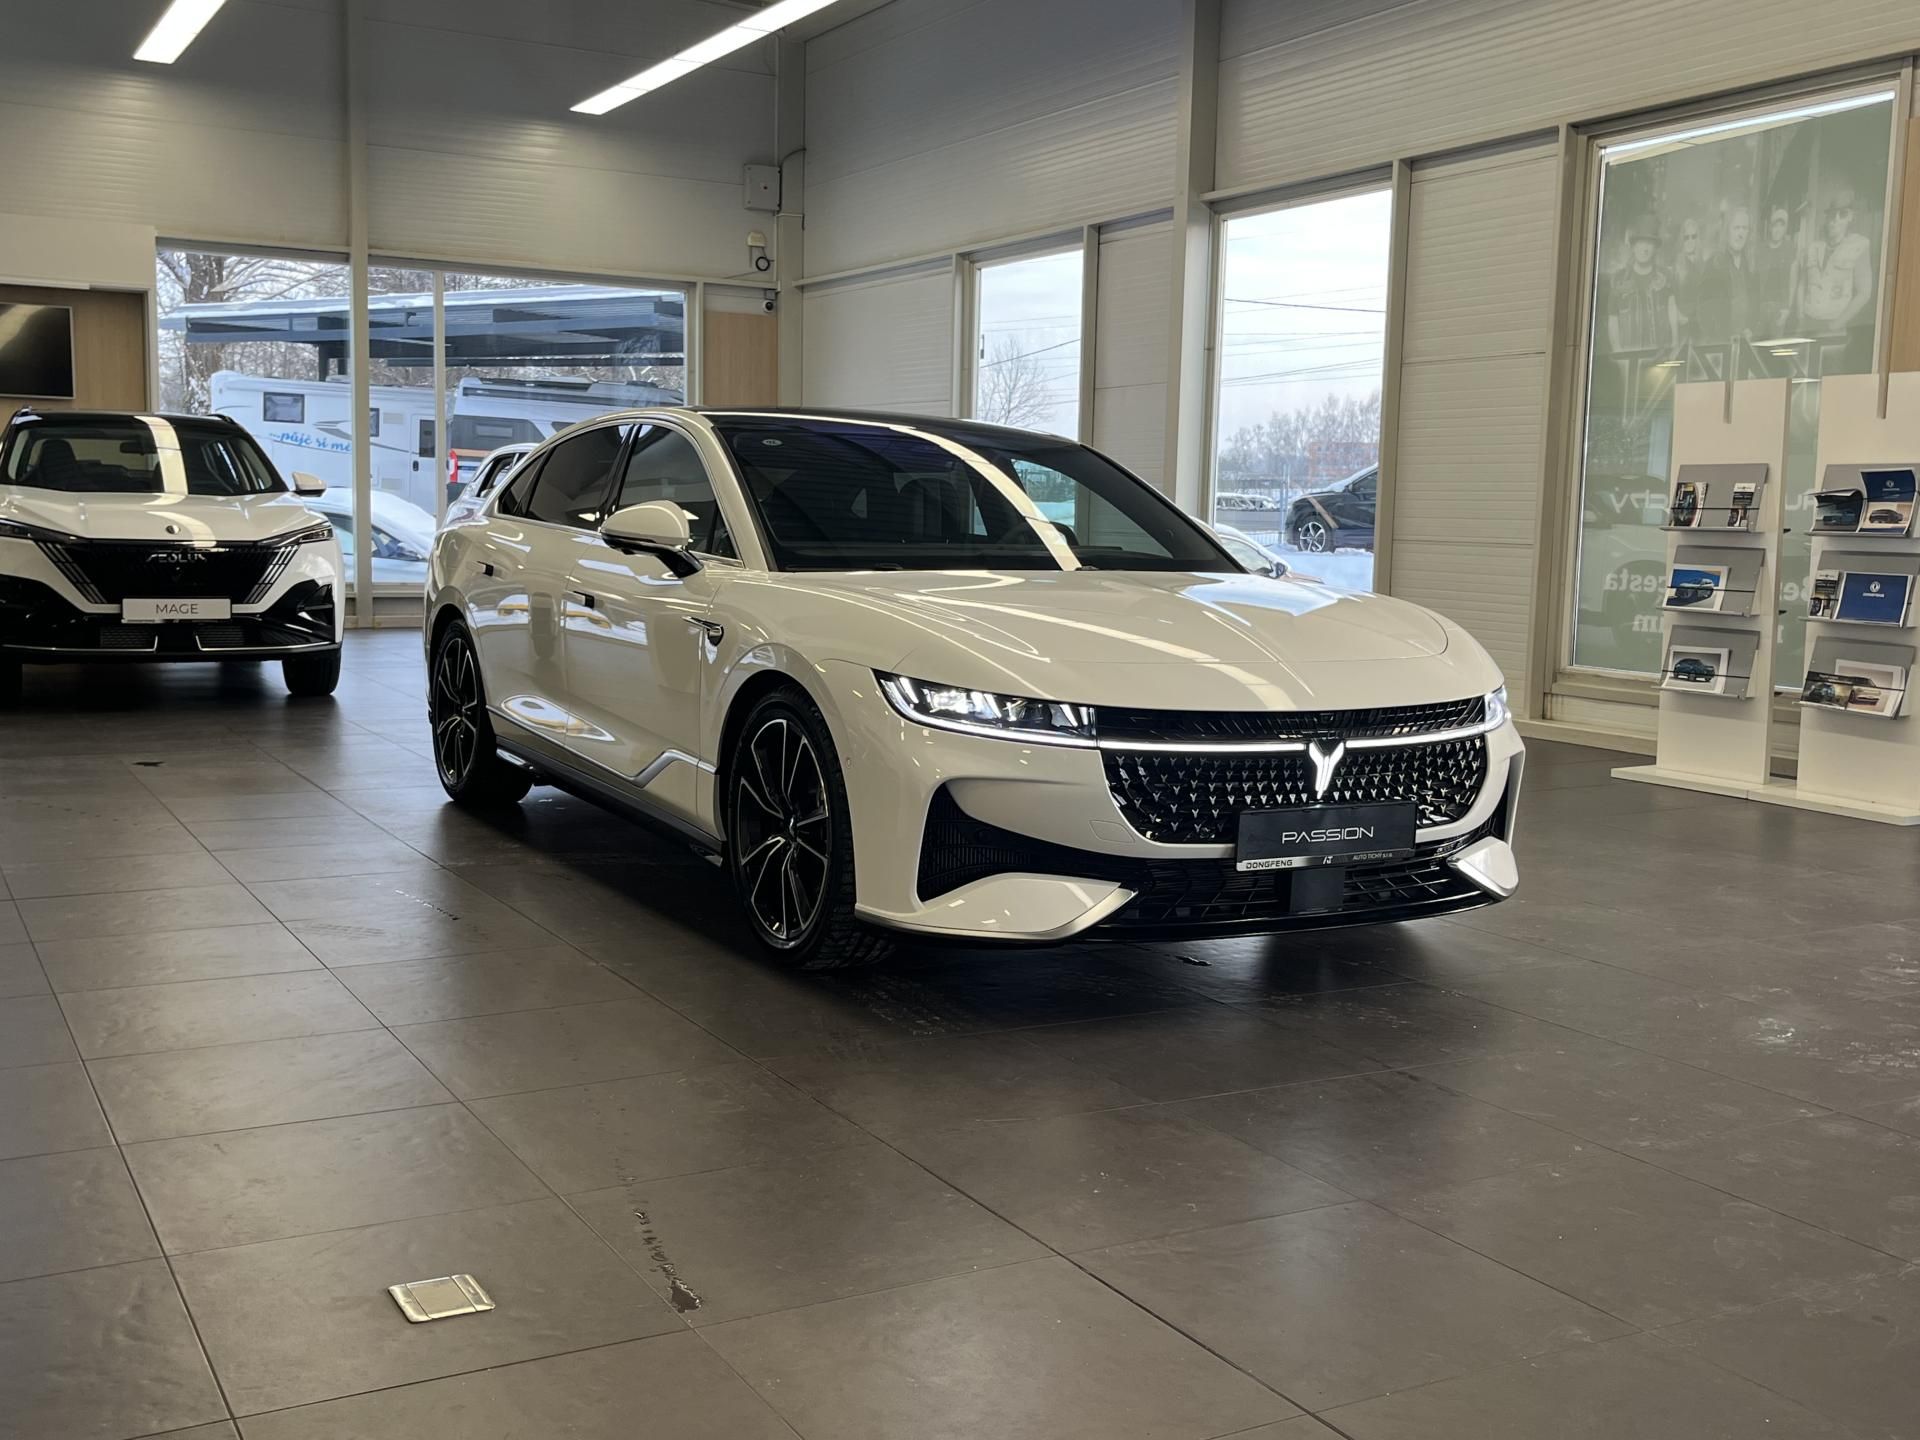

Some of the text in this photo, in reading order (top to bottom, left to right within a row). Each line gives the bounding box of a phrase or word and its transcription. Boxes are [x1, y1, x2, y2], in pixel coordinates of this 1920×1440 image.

[156, 603, 199, 614] MAGE
[1282, 826, 1374, 844] PASSION
[1246, 859, 1293, 869] DONGFENG
